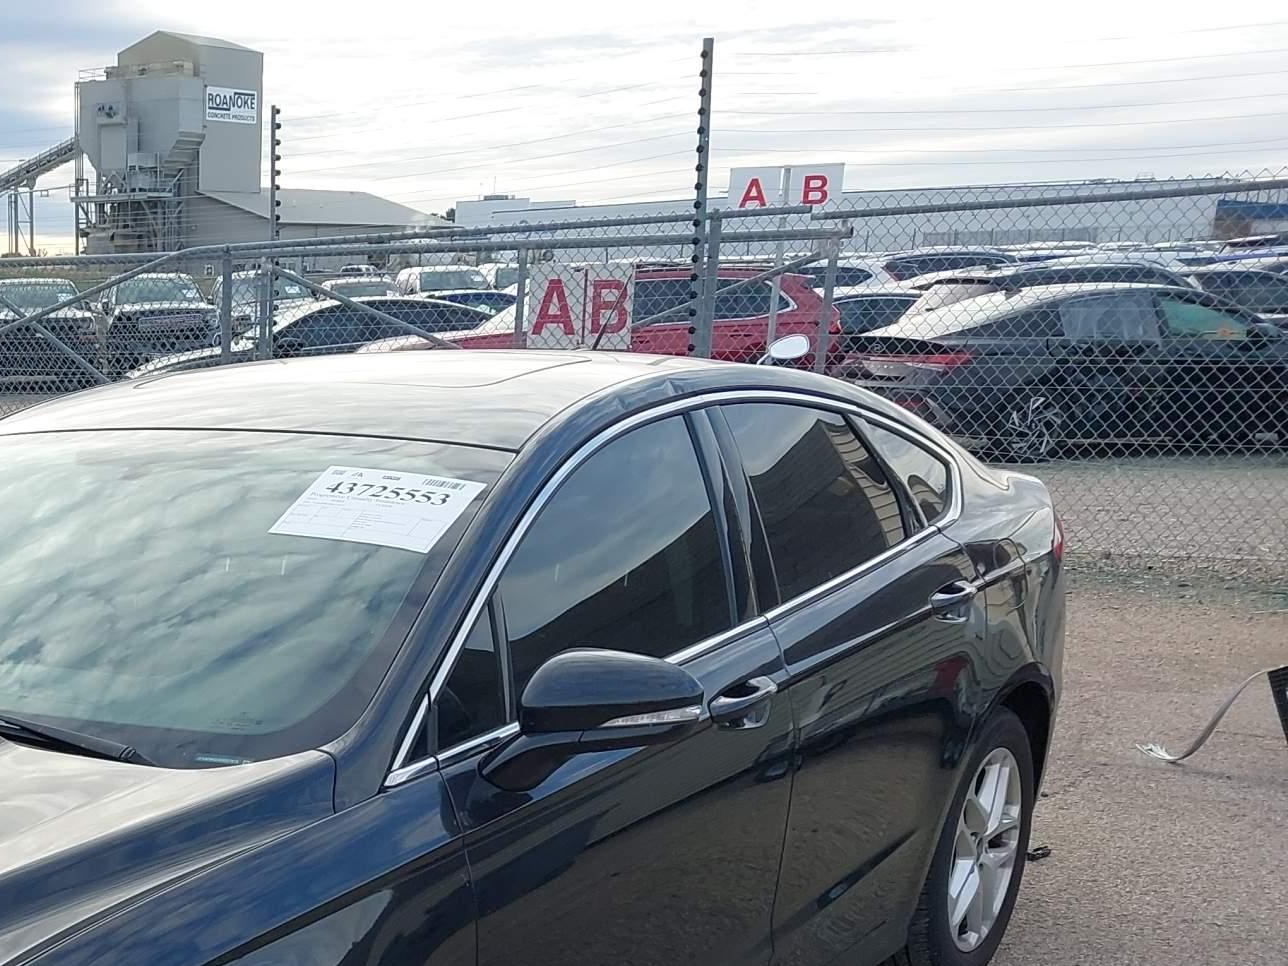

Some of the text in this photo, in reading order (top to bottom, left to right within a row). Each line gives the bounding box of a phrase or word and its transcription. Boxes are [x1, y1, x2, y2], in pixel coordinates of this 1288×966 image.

[208, 92, 255, 111] ROANOKE
[739, 175, 829, 208] A B
[531, 279, 629, 336] A B
[325, 481, 451, 506] 43725553
